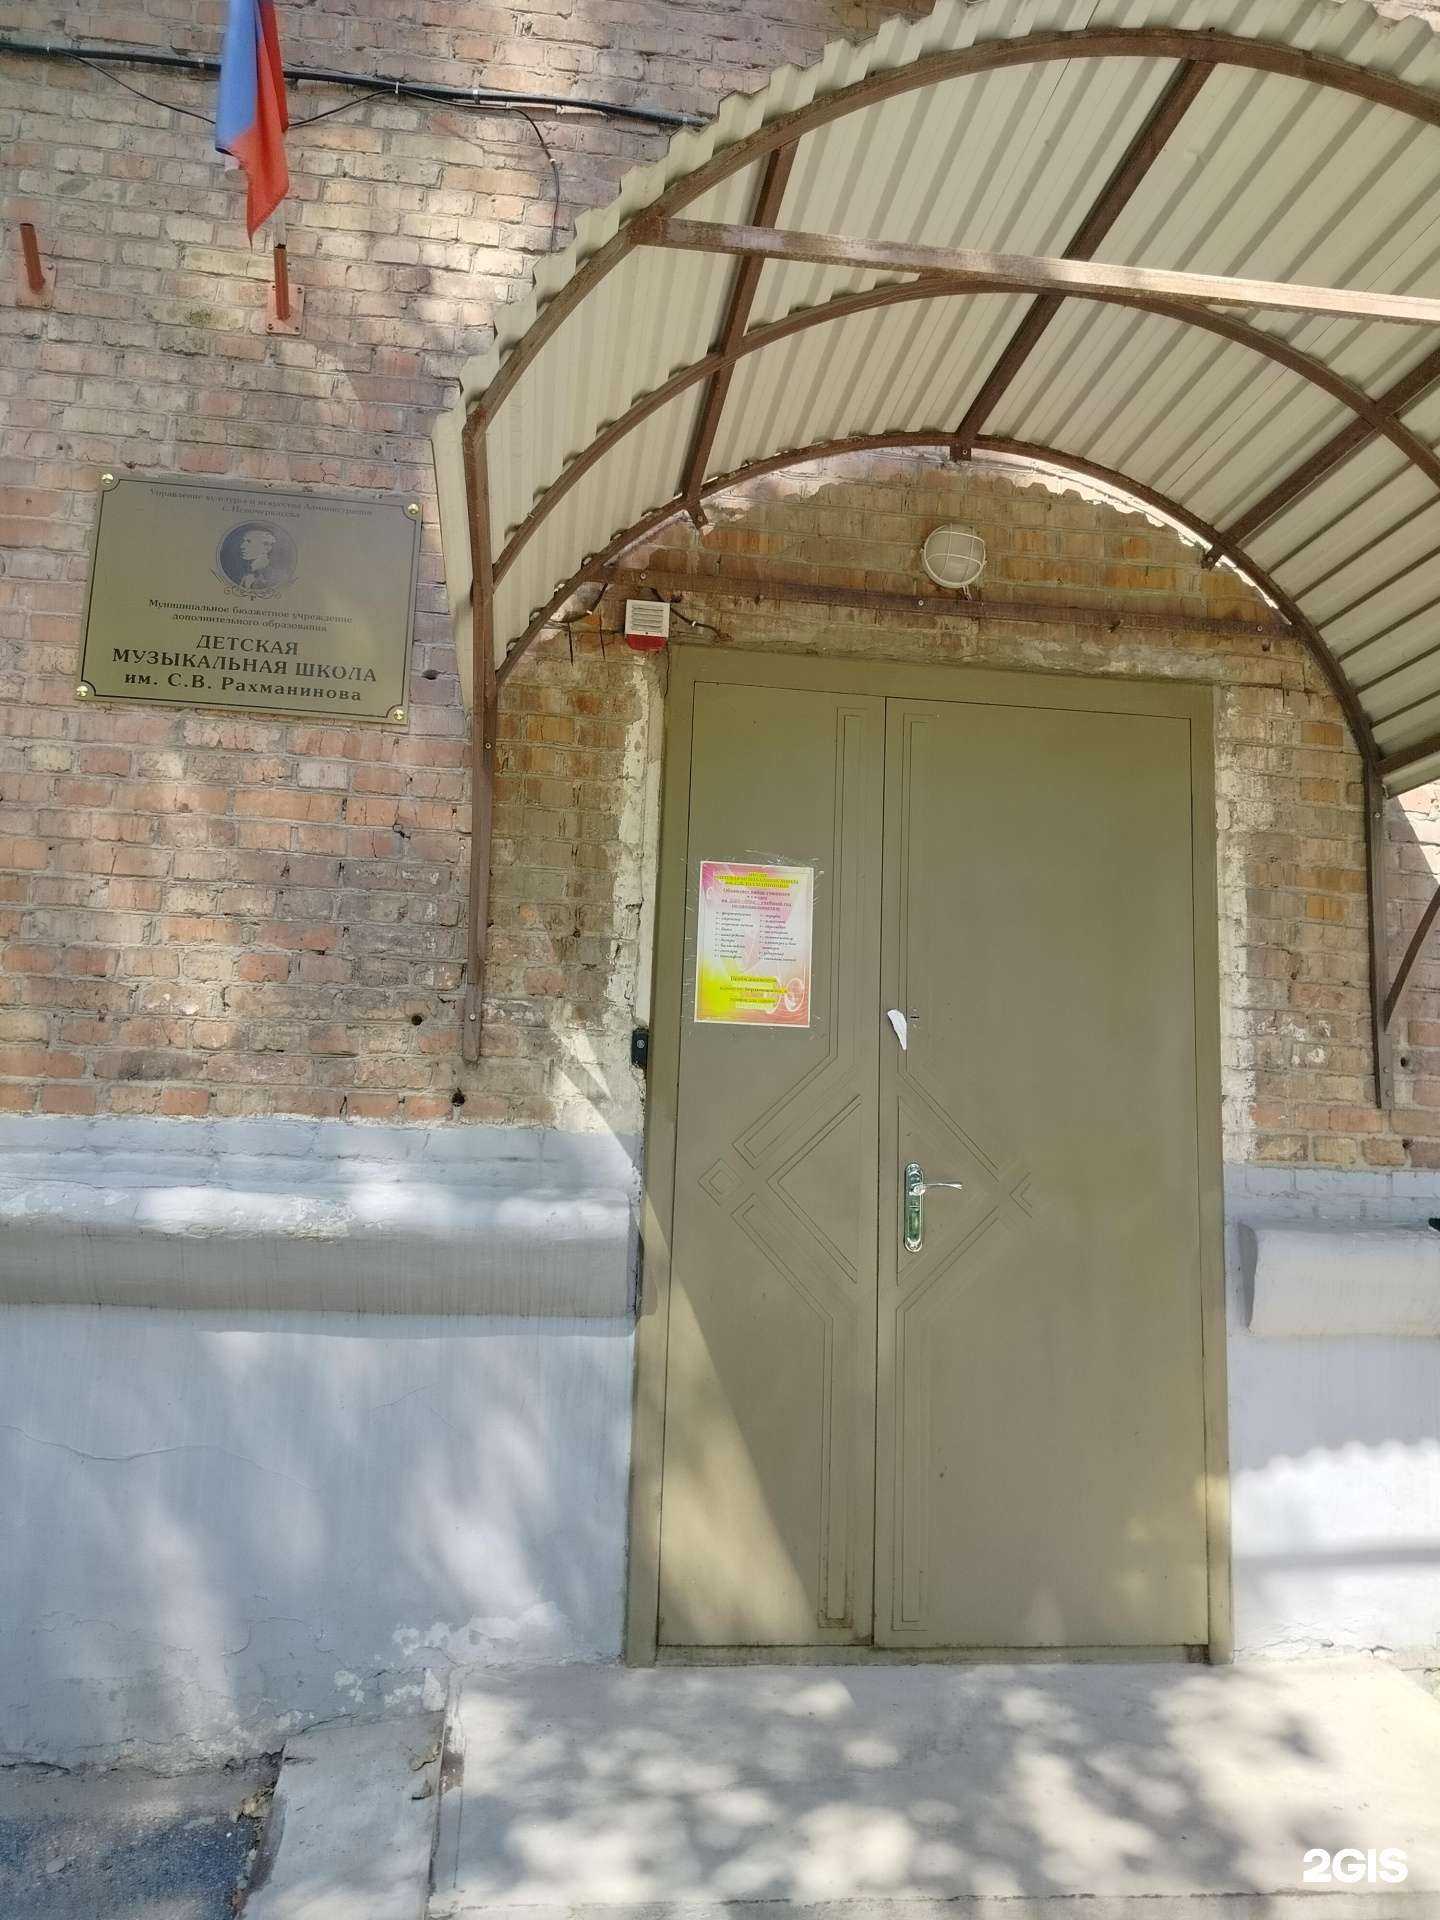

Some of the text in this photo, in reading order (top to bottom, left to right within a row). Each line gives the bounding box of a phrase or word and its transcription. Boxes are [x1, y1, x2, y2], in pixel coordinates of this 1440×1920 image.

[149, 599, 353, 624] Муниципальное бюджетное учреждение
[172, 613, 327, 632] дополнительного образования
[196, 634, 298, 656] ДЕТСКАЯ
[112, 647, 377, 682] МУЗЫКАЛЬНАЯ ШКОЛА
[124, 673, 361, 702] им. С.В. Рахманинова
